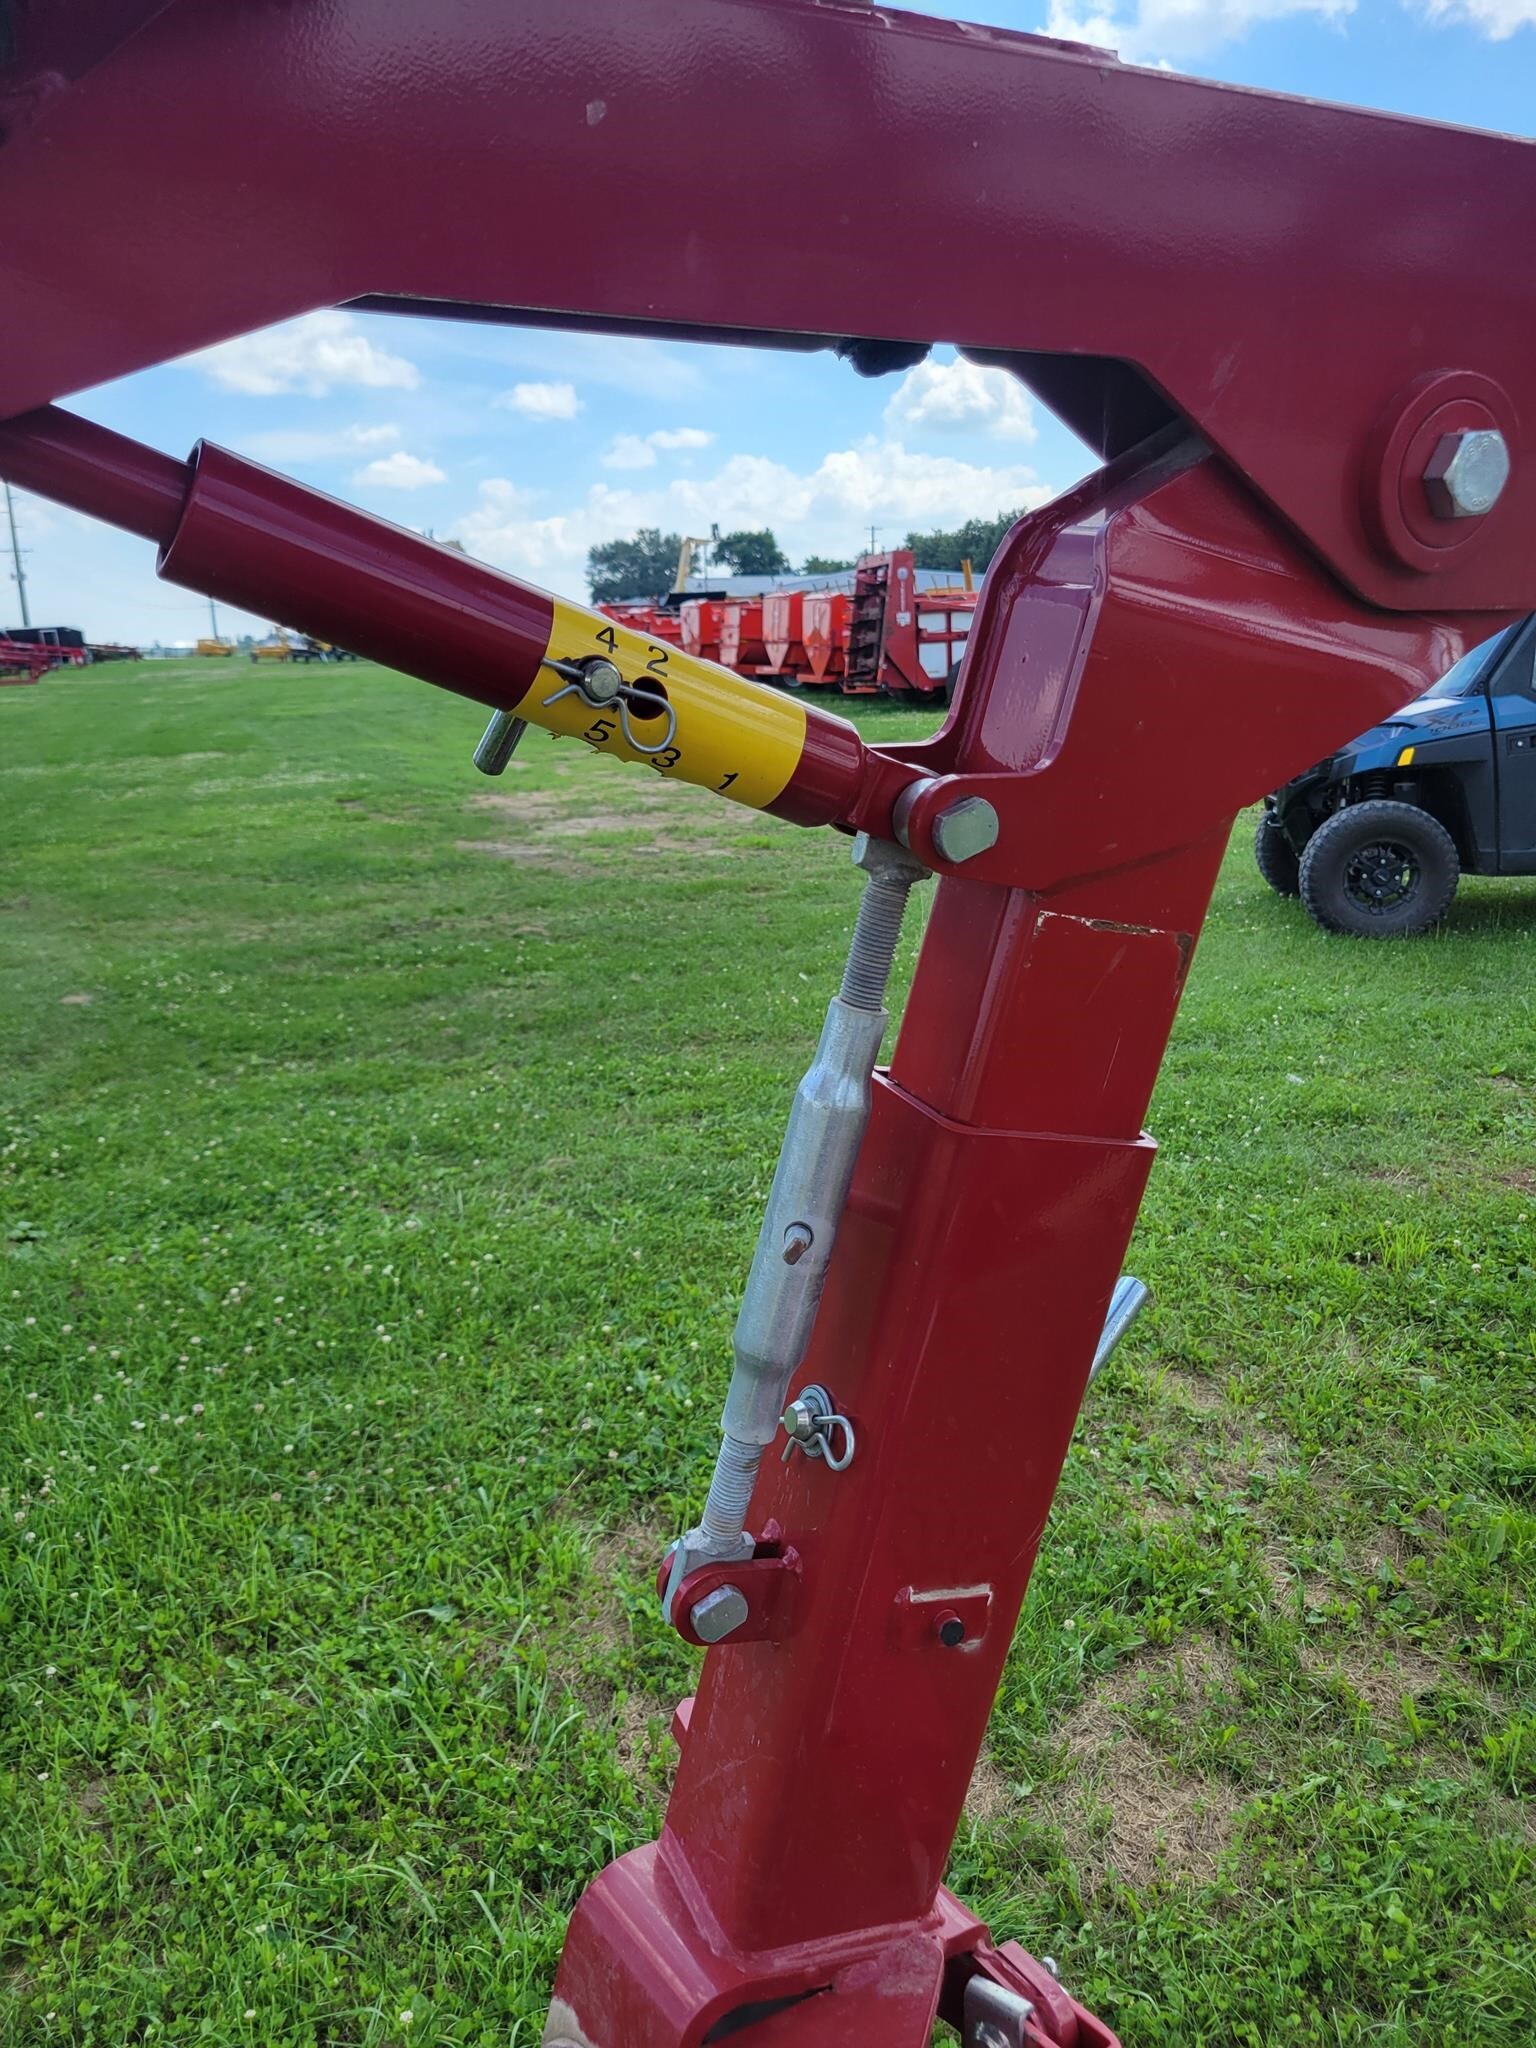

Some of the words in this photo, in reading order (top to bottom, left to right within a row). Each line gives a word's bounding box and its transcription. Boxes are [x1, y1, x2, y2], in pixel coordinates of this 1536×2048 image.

[595, 626, 619, 654] 4
[646, 645, 669, 678] 2
[583, 718, 617, 742] 5
[651, 746, 682, 768] 3
[718, 772, 739, 790] 1
